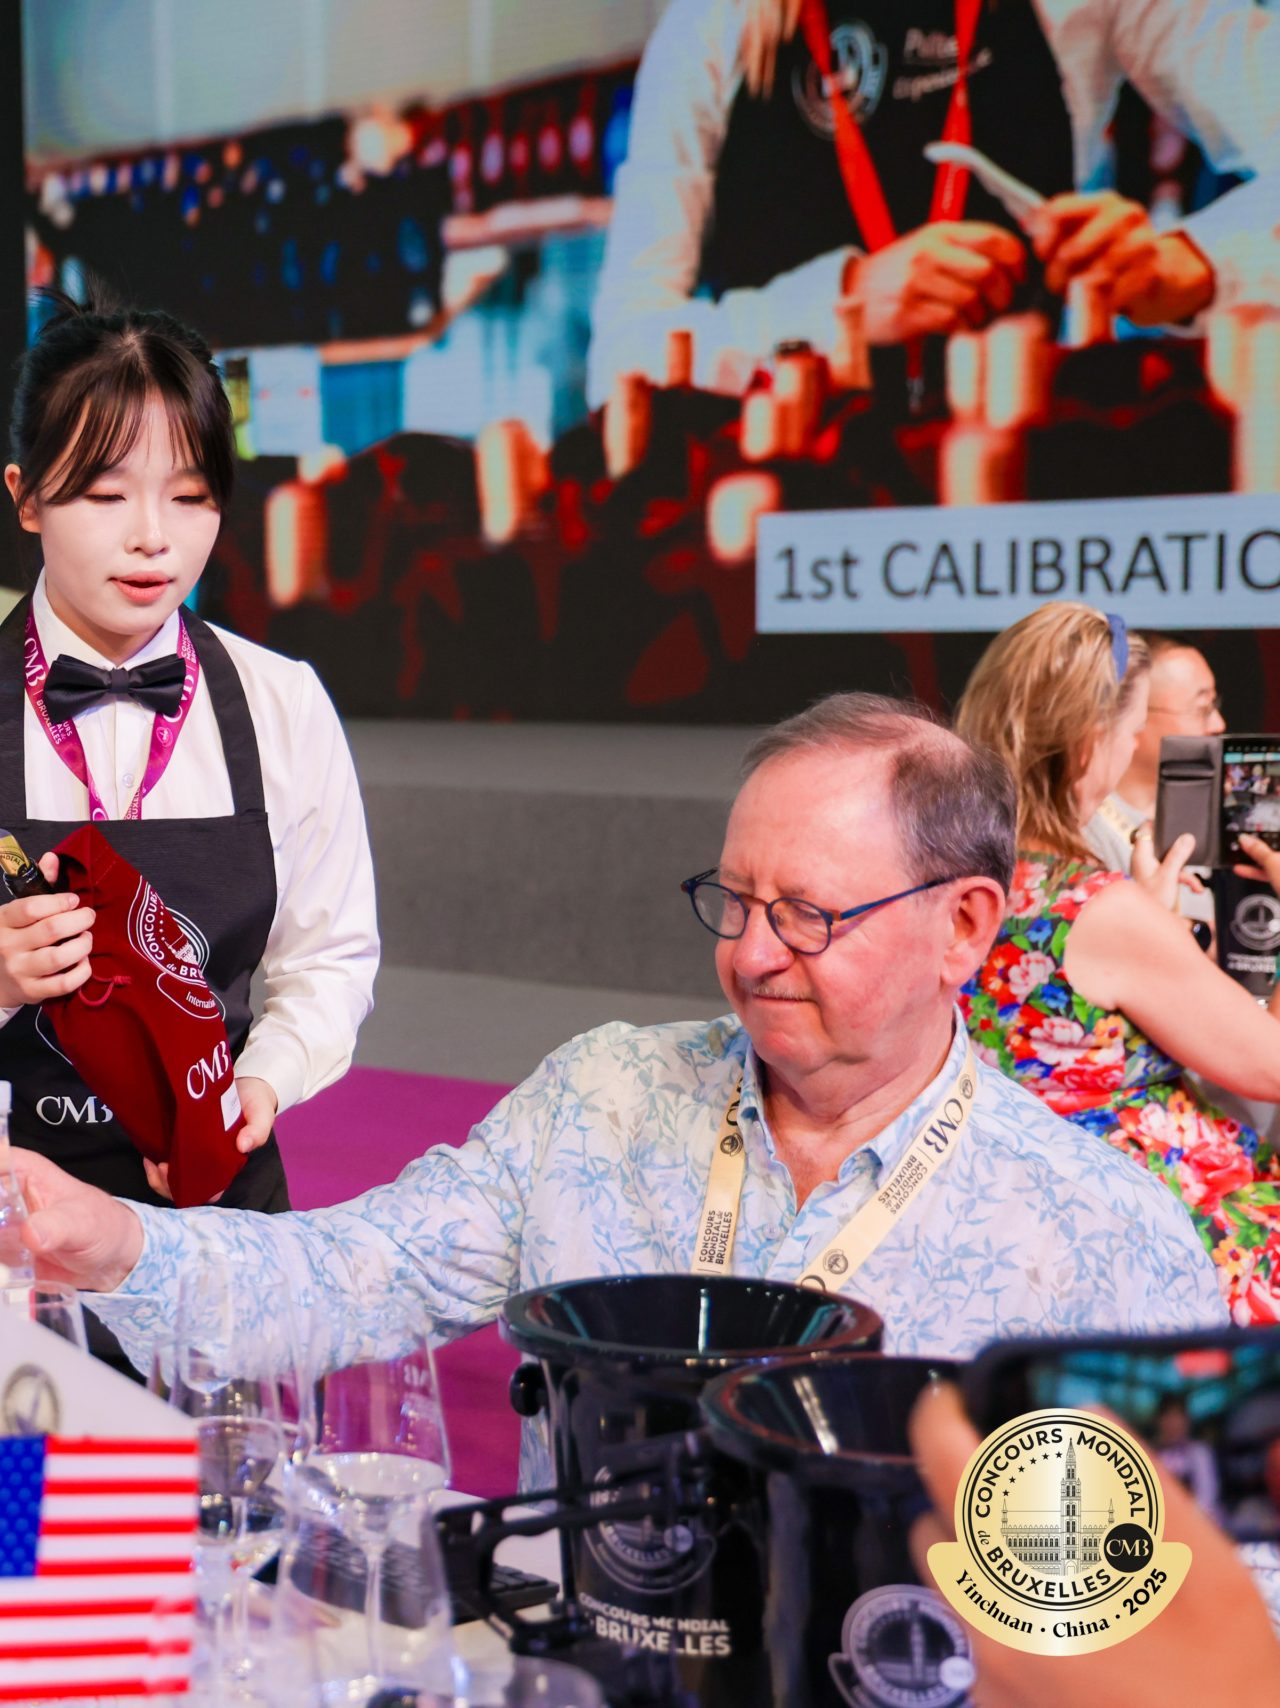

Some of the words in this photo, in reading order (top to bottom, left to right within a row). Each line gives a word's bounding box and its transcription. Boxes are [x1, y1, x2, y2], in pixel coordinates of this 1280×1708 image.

[775, 544, 861, 601] 1st
[166, 963, 177, 972] de
[923, 1098, 964, 1154] CMB
[877, 1154, 917, 1204] BRUXELLES
[889, 1166, 928, 1215] CONCOURS
[892, 1161, 923, 1201] MONDIAL
[699, 1210, 716, 1263] CONCOURS
[707, 1218, 722, 1264] MONDIAL
[715, 1211, 732, 1265] BRUXELLES
[595, 1616, 732, 1656] BRUXELES
